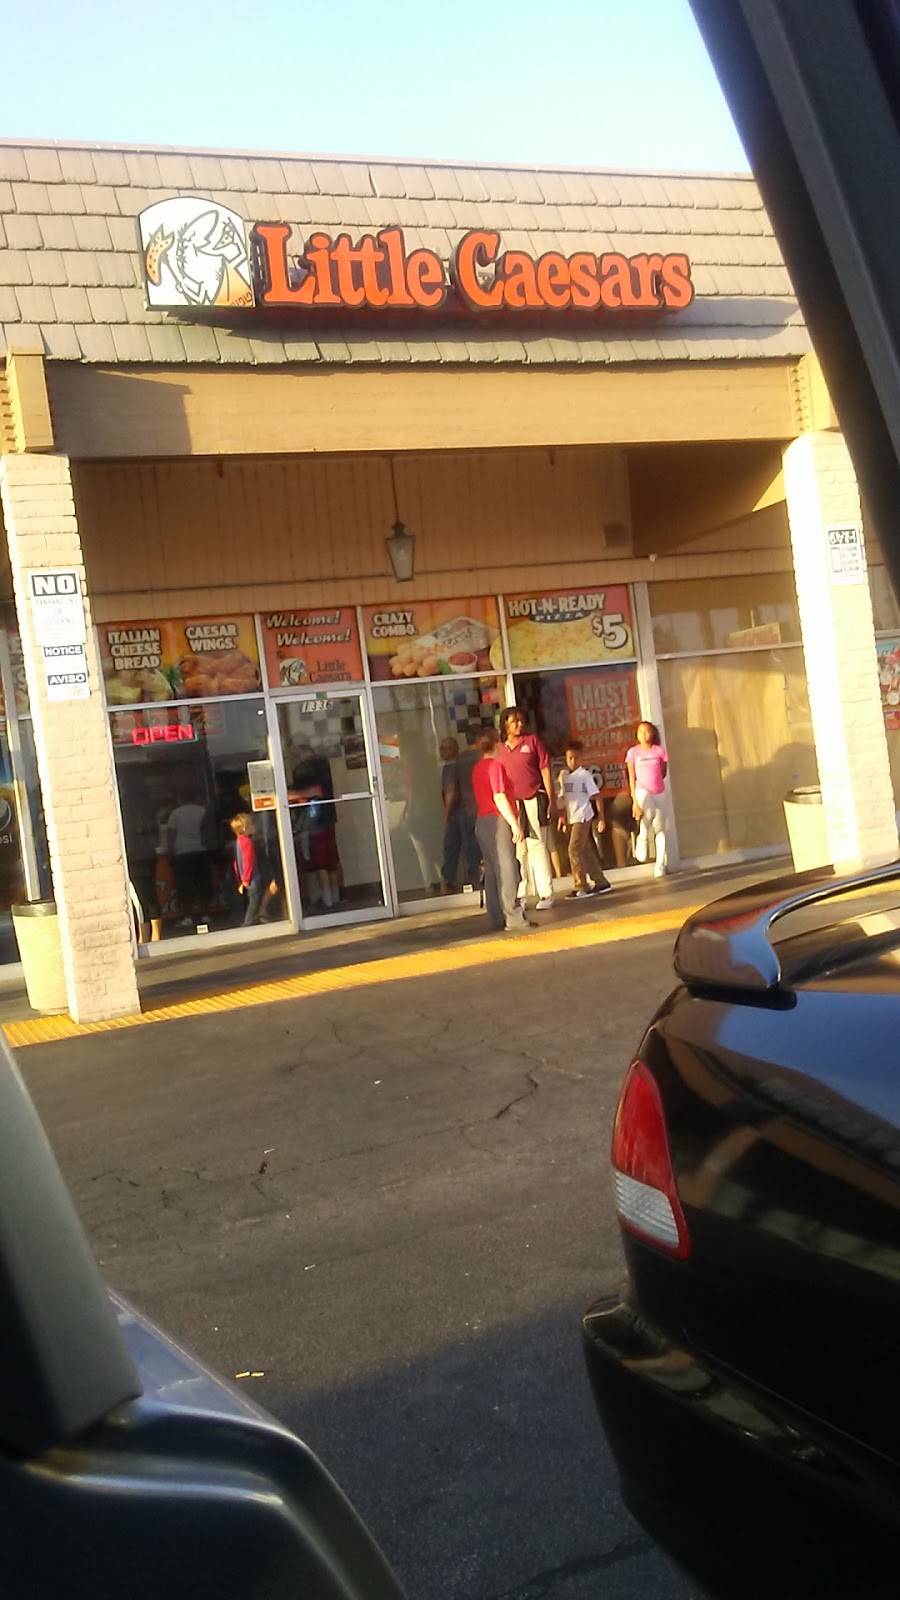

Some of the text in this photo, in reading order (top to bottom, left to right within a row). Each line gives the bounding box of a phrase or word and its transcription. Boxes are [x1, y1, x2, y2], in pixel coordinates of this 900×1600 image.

[254, 222, 694, 310] Little Caesars
[32, 574, 77, 596] NO
[508, 593, 605, 617] HOT-N-READY
[266, 610, 341, 628] Welcome!
[373, 611, 413, 625] CRAZY
[535, 612, 583, 622] PIZZA
[107, 629, 160, 645] ITALIAN
[185, 624, 237, 640] CAESAR
[277, 628, 352, 647] Welcome!
[371, 624, 416, 639] COMBO
[592, 614, 629, 649] $5
[44, 644, 83, 657] NOTICE
[110, 643, 161, 657] CHEESE
[114, 655, 160, 671] BREAD
[48, 673, 86, 685] AVISO
[572, 680, 629, 709] MOST
[575, 706, 632, 731] CHEESE
[132, 724, 194, 746] OPEN
